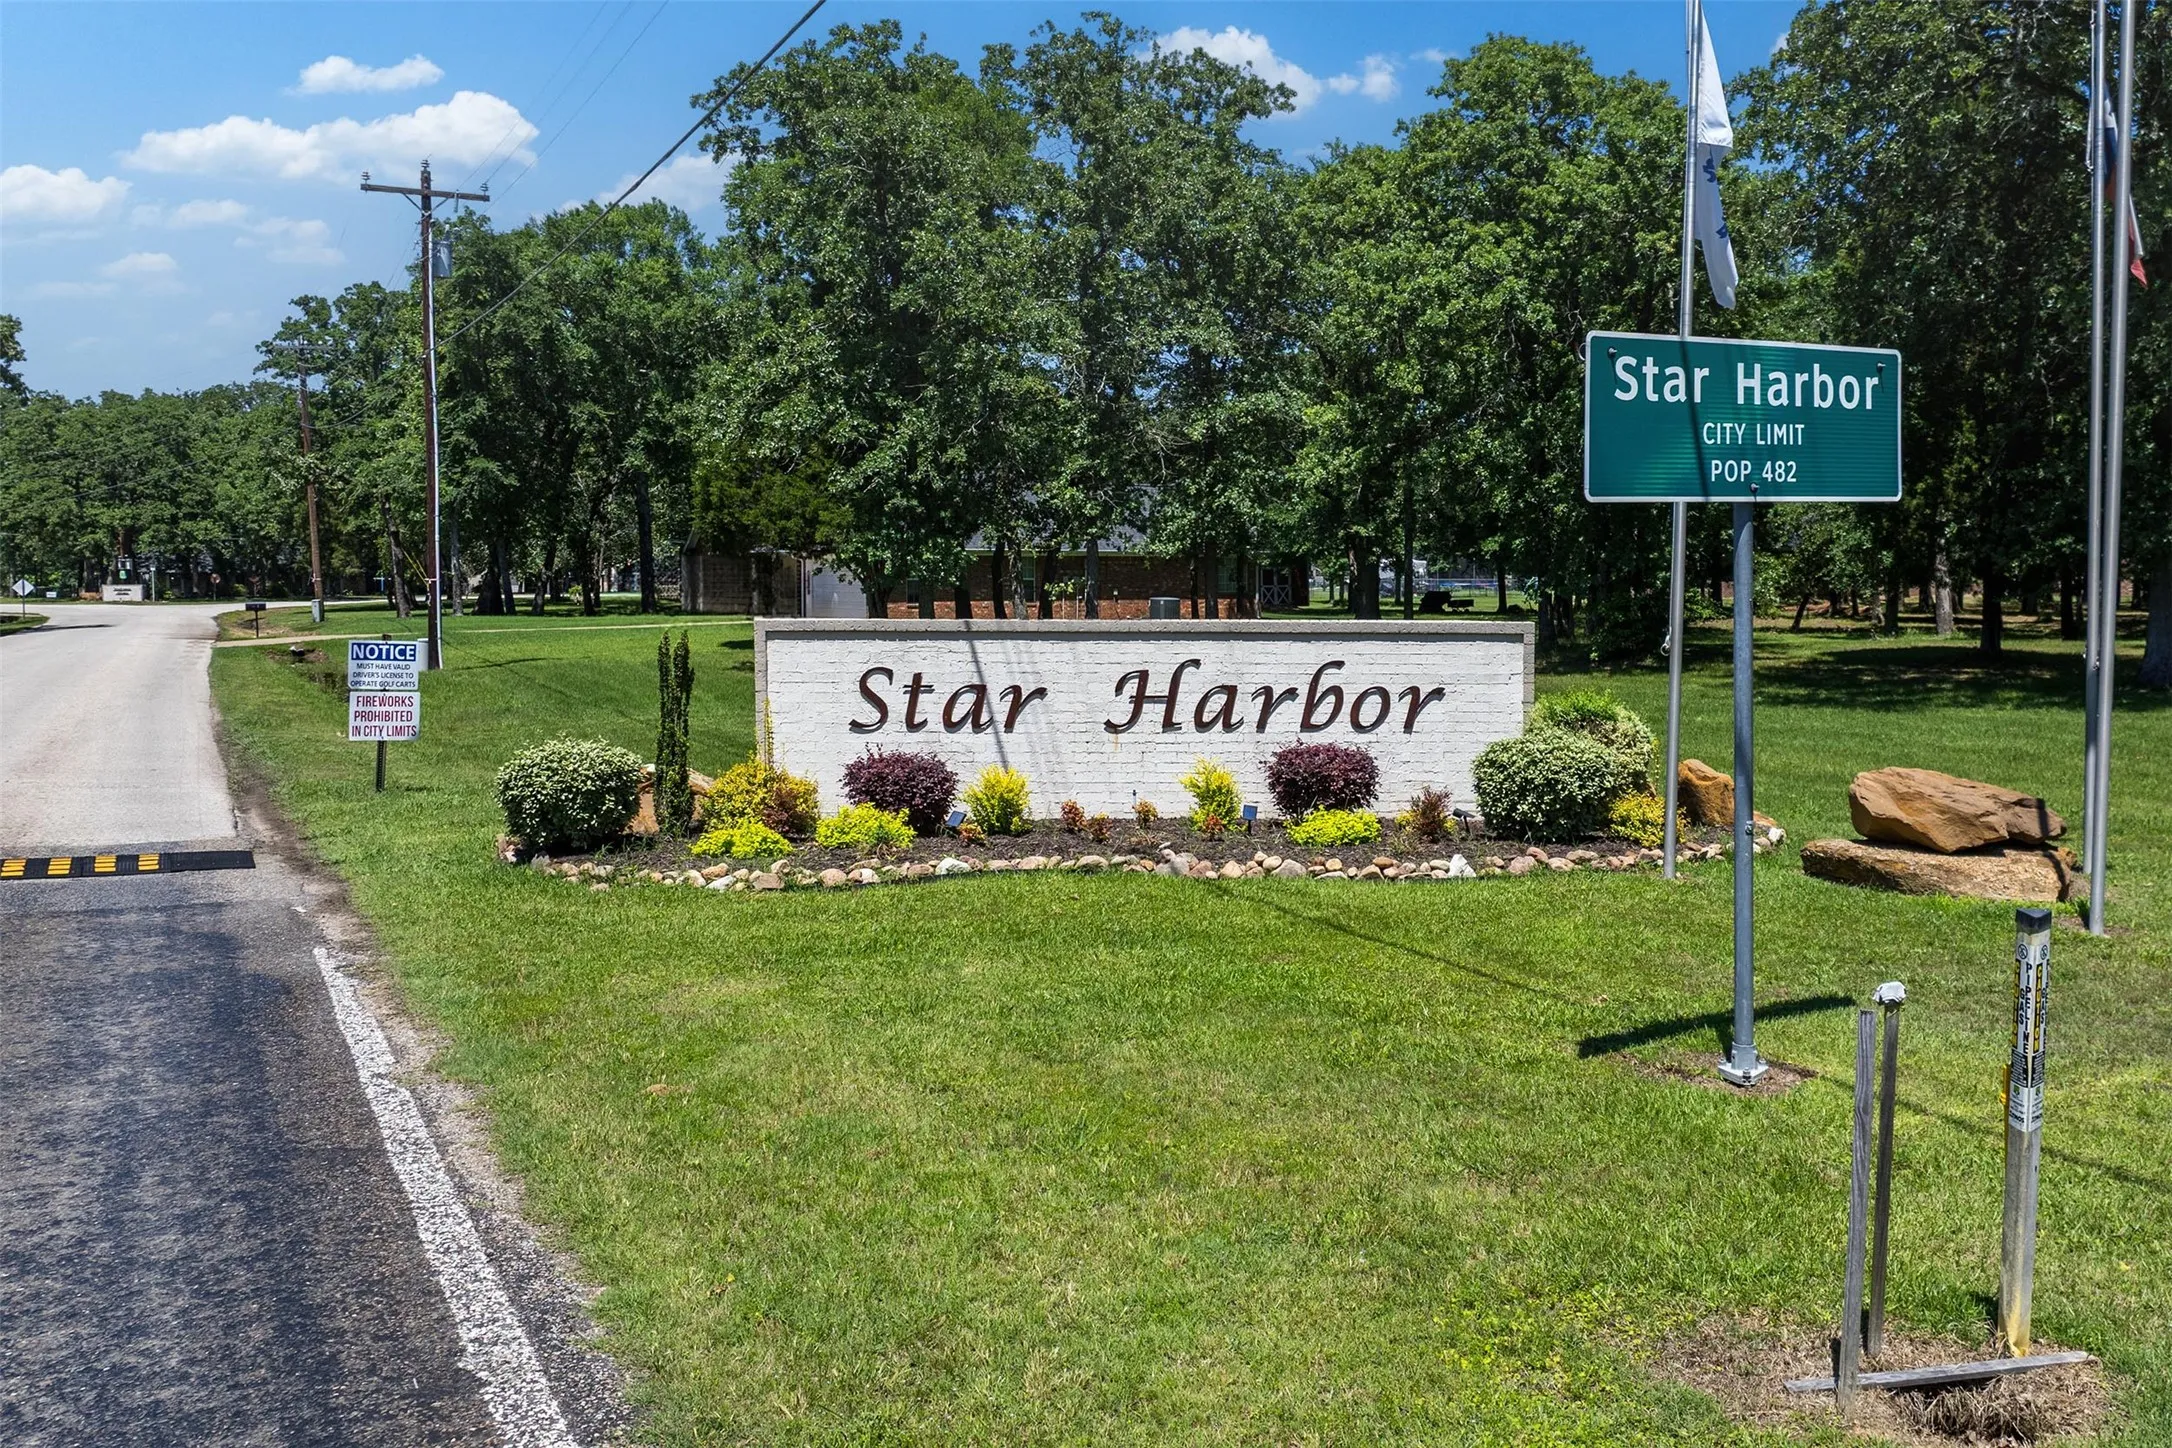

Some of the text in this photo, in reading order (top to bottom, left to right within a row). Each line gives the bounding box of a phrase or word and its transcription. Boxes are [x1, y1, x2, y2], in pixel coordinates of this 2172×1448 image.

[1613, 355, 1879, 410] Star Harbor
[1702, 422, 1805, 446] CITY LIMIT
[1711, 459, 1797, 483] POP 482
[352, 644, 415, 660] NOTICE
[356, 662, 374, 670] MUST
[379, 680, 395, 688] GOLF
[356, 695, 414, 707] FIREWORKS
[848, 658, 1446, 735] Star Harbor
[354, 710, 413, 722] PROHIBITED
[352, 725, 417, 737] IN CITY LIMITS
[2022, 961, 2033, 1054] PIPELINE
